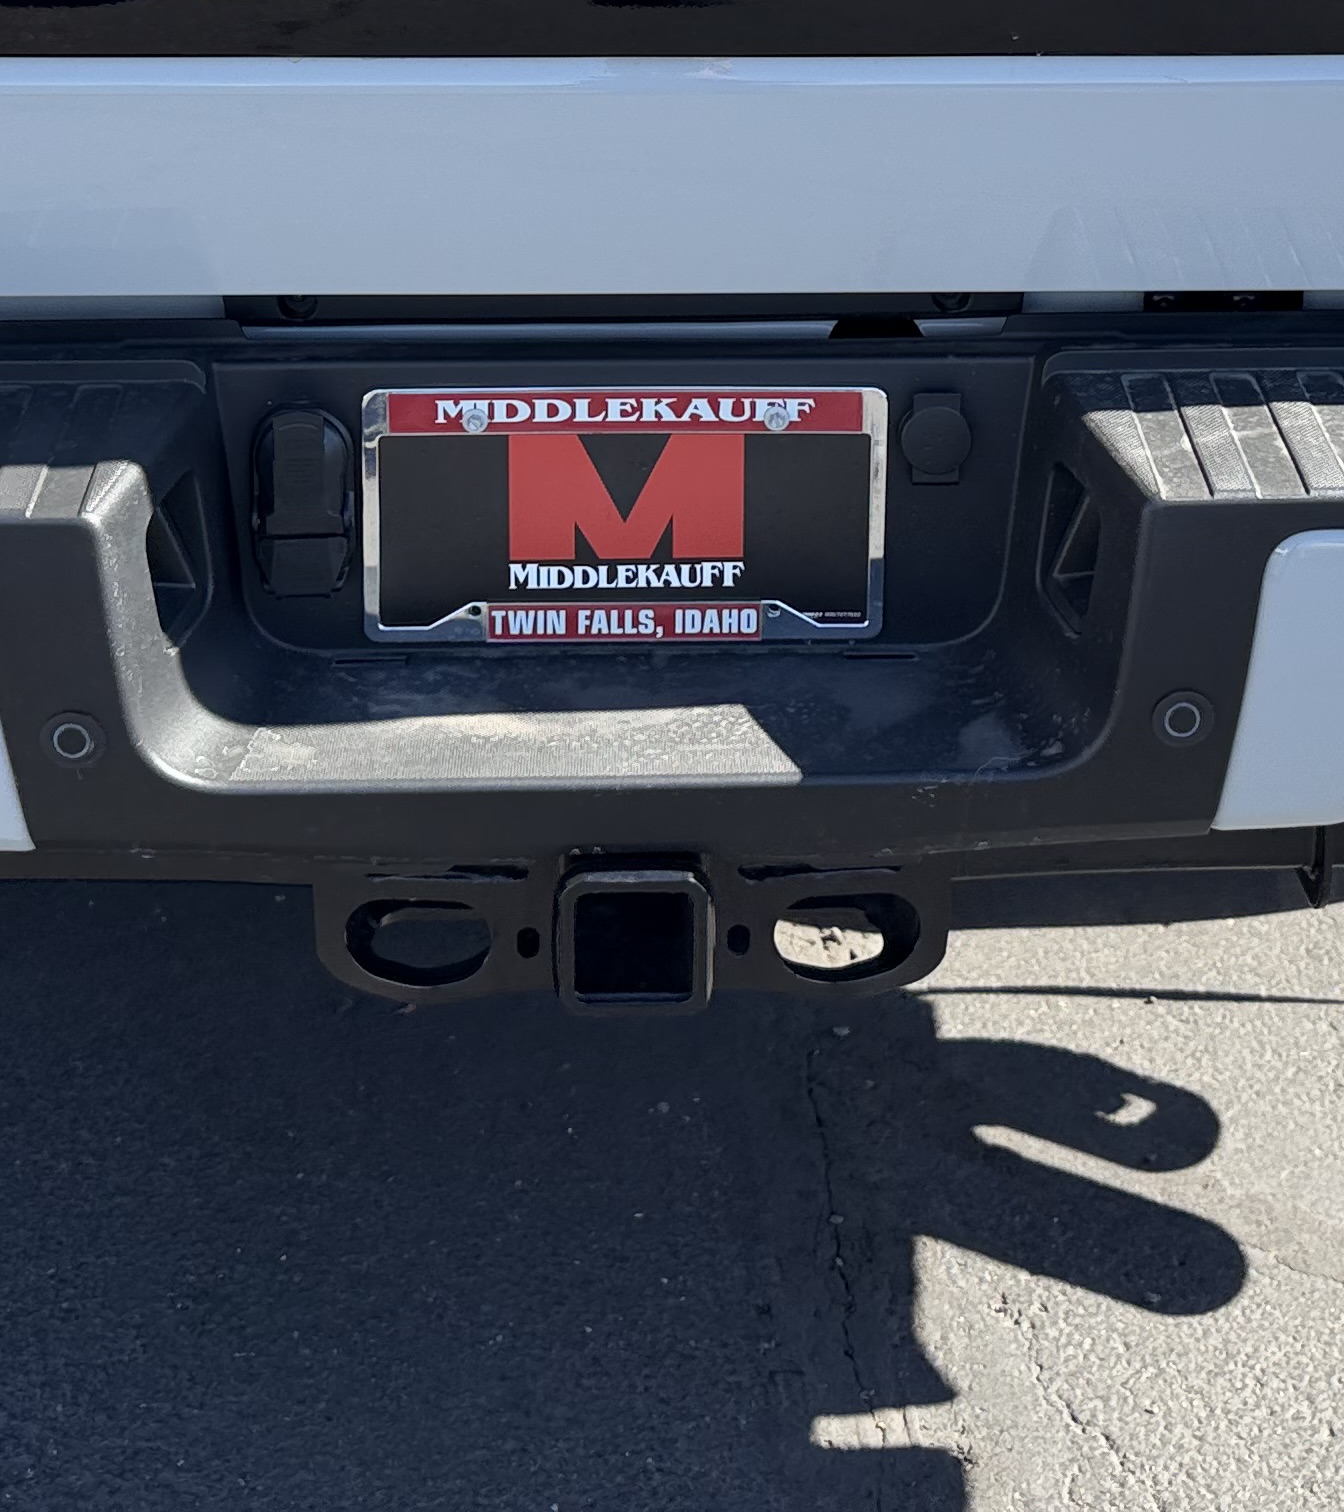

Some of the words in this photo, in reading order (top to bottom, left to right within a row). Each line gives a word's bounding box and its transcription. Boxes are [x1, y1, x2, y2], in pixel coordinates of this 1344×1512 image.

[509, 433, 745, 559] M
[508, 561, 745, 590] MIDDLEKAUFF
[491, 609, 567, 637] TWIN
[577, 608, 665, 639] FALLS,
[674, 607, 758, 635] IDAHO
